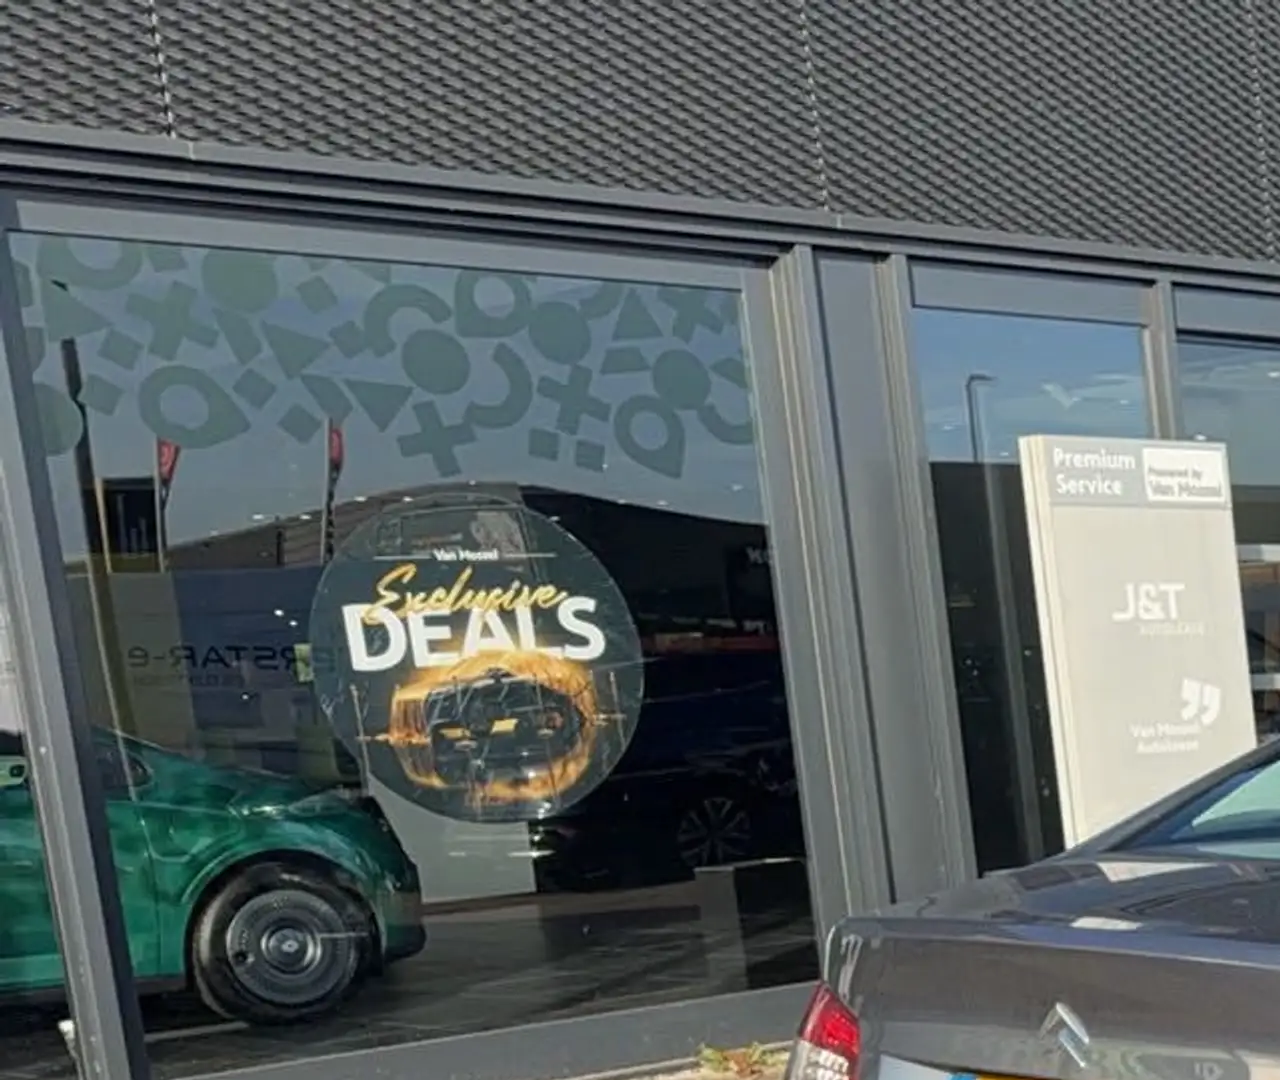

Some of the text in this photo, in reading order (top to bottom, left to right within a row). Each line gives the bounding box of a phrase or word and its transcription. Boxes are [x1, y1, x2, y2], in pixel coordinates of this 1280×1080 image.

[1053, 448, 1136, 469] Premium
[1055, 474, 1123, 496] Service
[1112, 582, 1186, 621] J&T
[342, 596, 606, 672] DEALS
